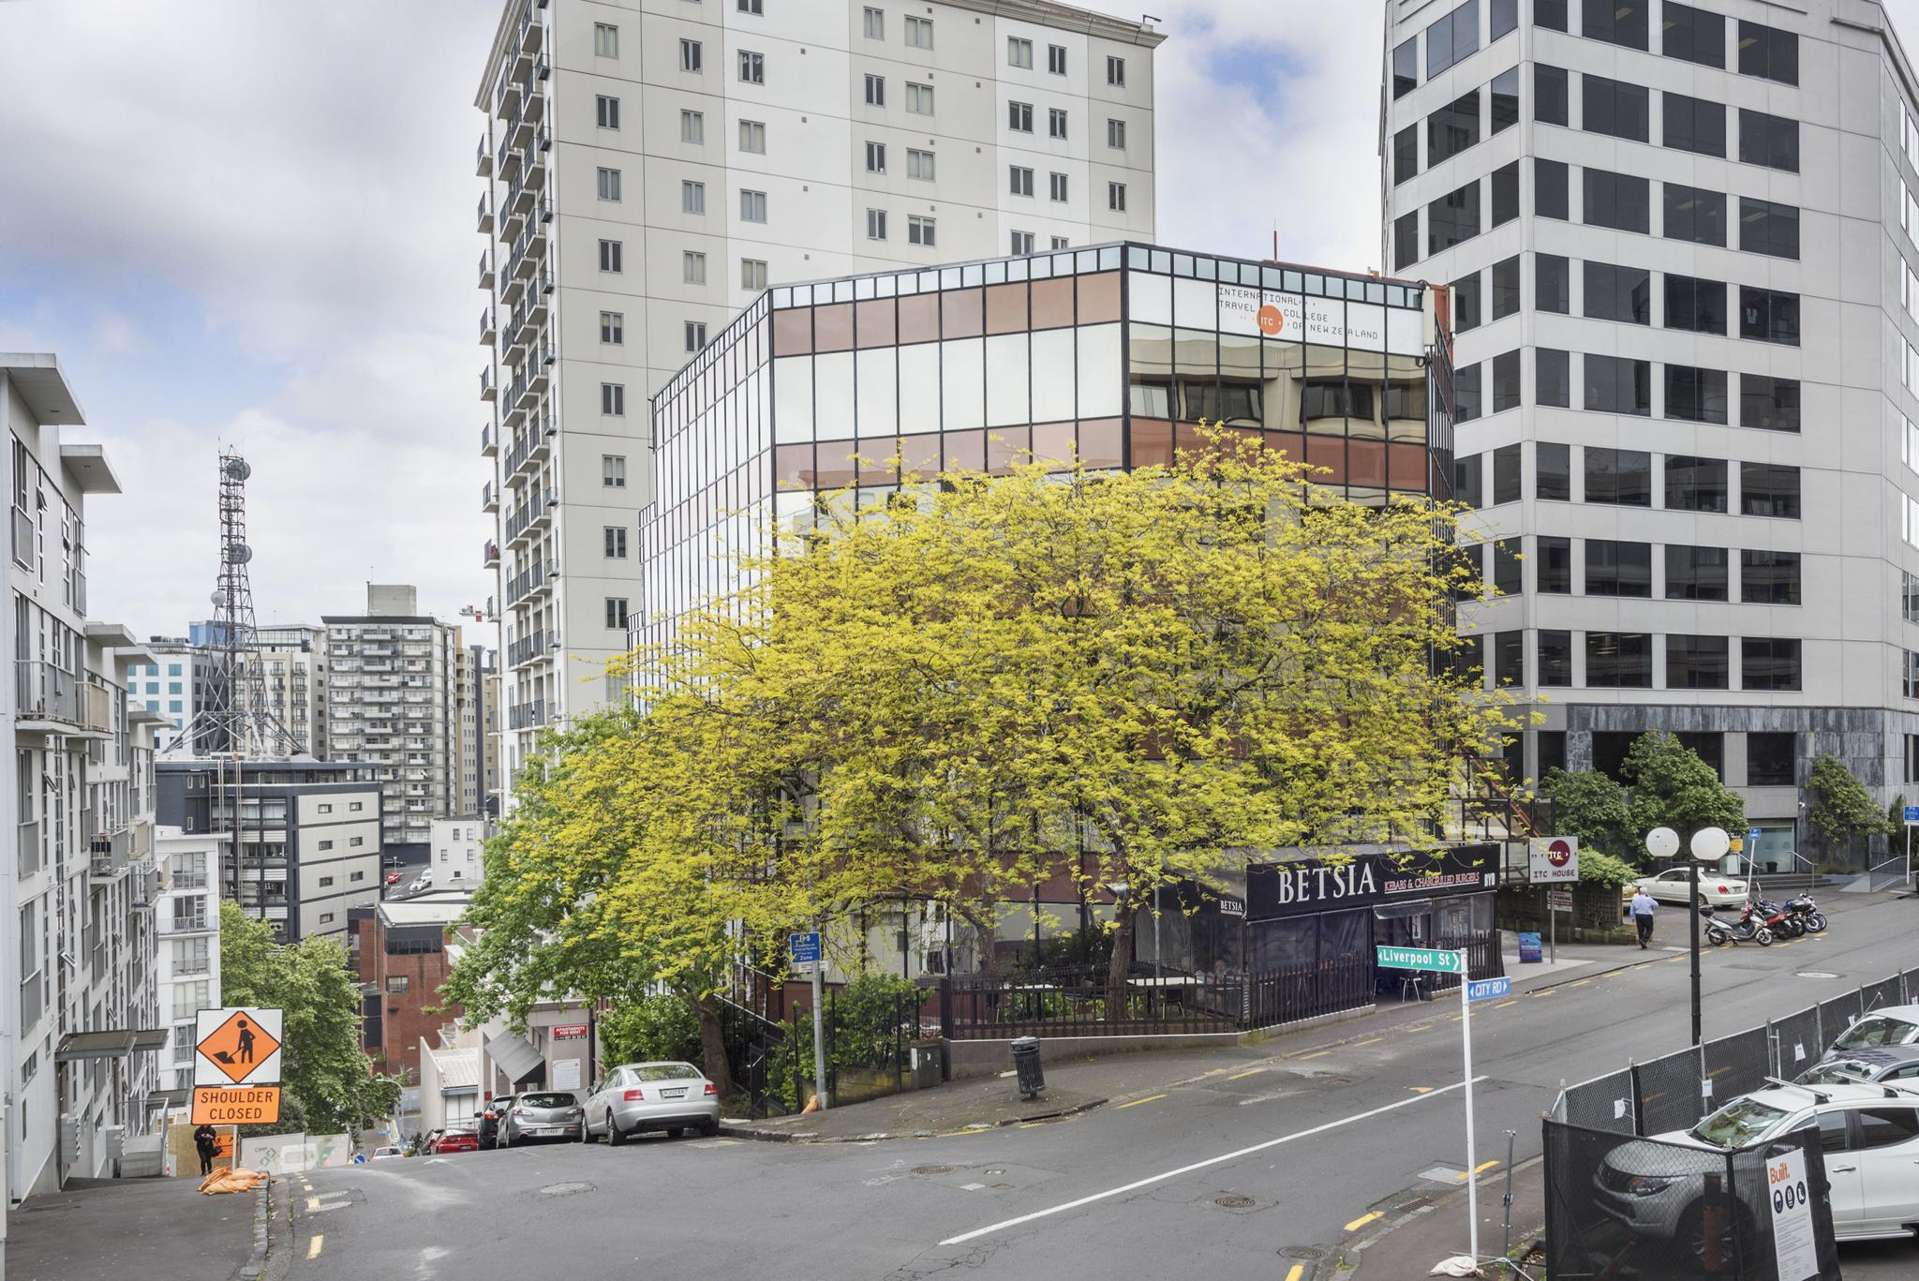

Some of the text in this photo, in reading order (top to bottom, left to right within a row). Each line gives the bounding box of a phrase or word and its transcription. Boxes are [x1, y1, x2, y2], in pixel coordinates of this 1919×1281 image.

[1220, 287, 1298, 306] INTERNATIONAL
[1220, 300, 1255, 312] TRAVEL
[1261, 316, 1274, 327] ITC
[1292, 321, 1304, 330] OF
[1533, 868, 1575, 878] ITC HOUSE
[1278, 862, 1377, 904] BETSIA
[1220, 900, 1243, 912] BETSIA
[1383, 949, 1450, 966] Liverpool St
[1475, 981, 1502, 996] CITY RD
[200, 1091, 273, 1104] SHOULDER
[209, 1107, 262, 1120] CLOSED
